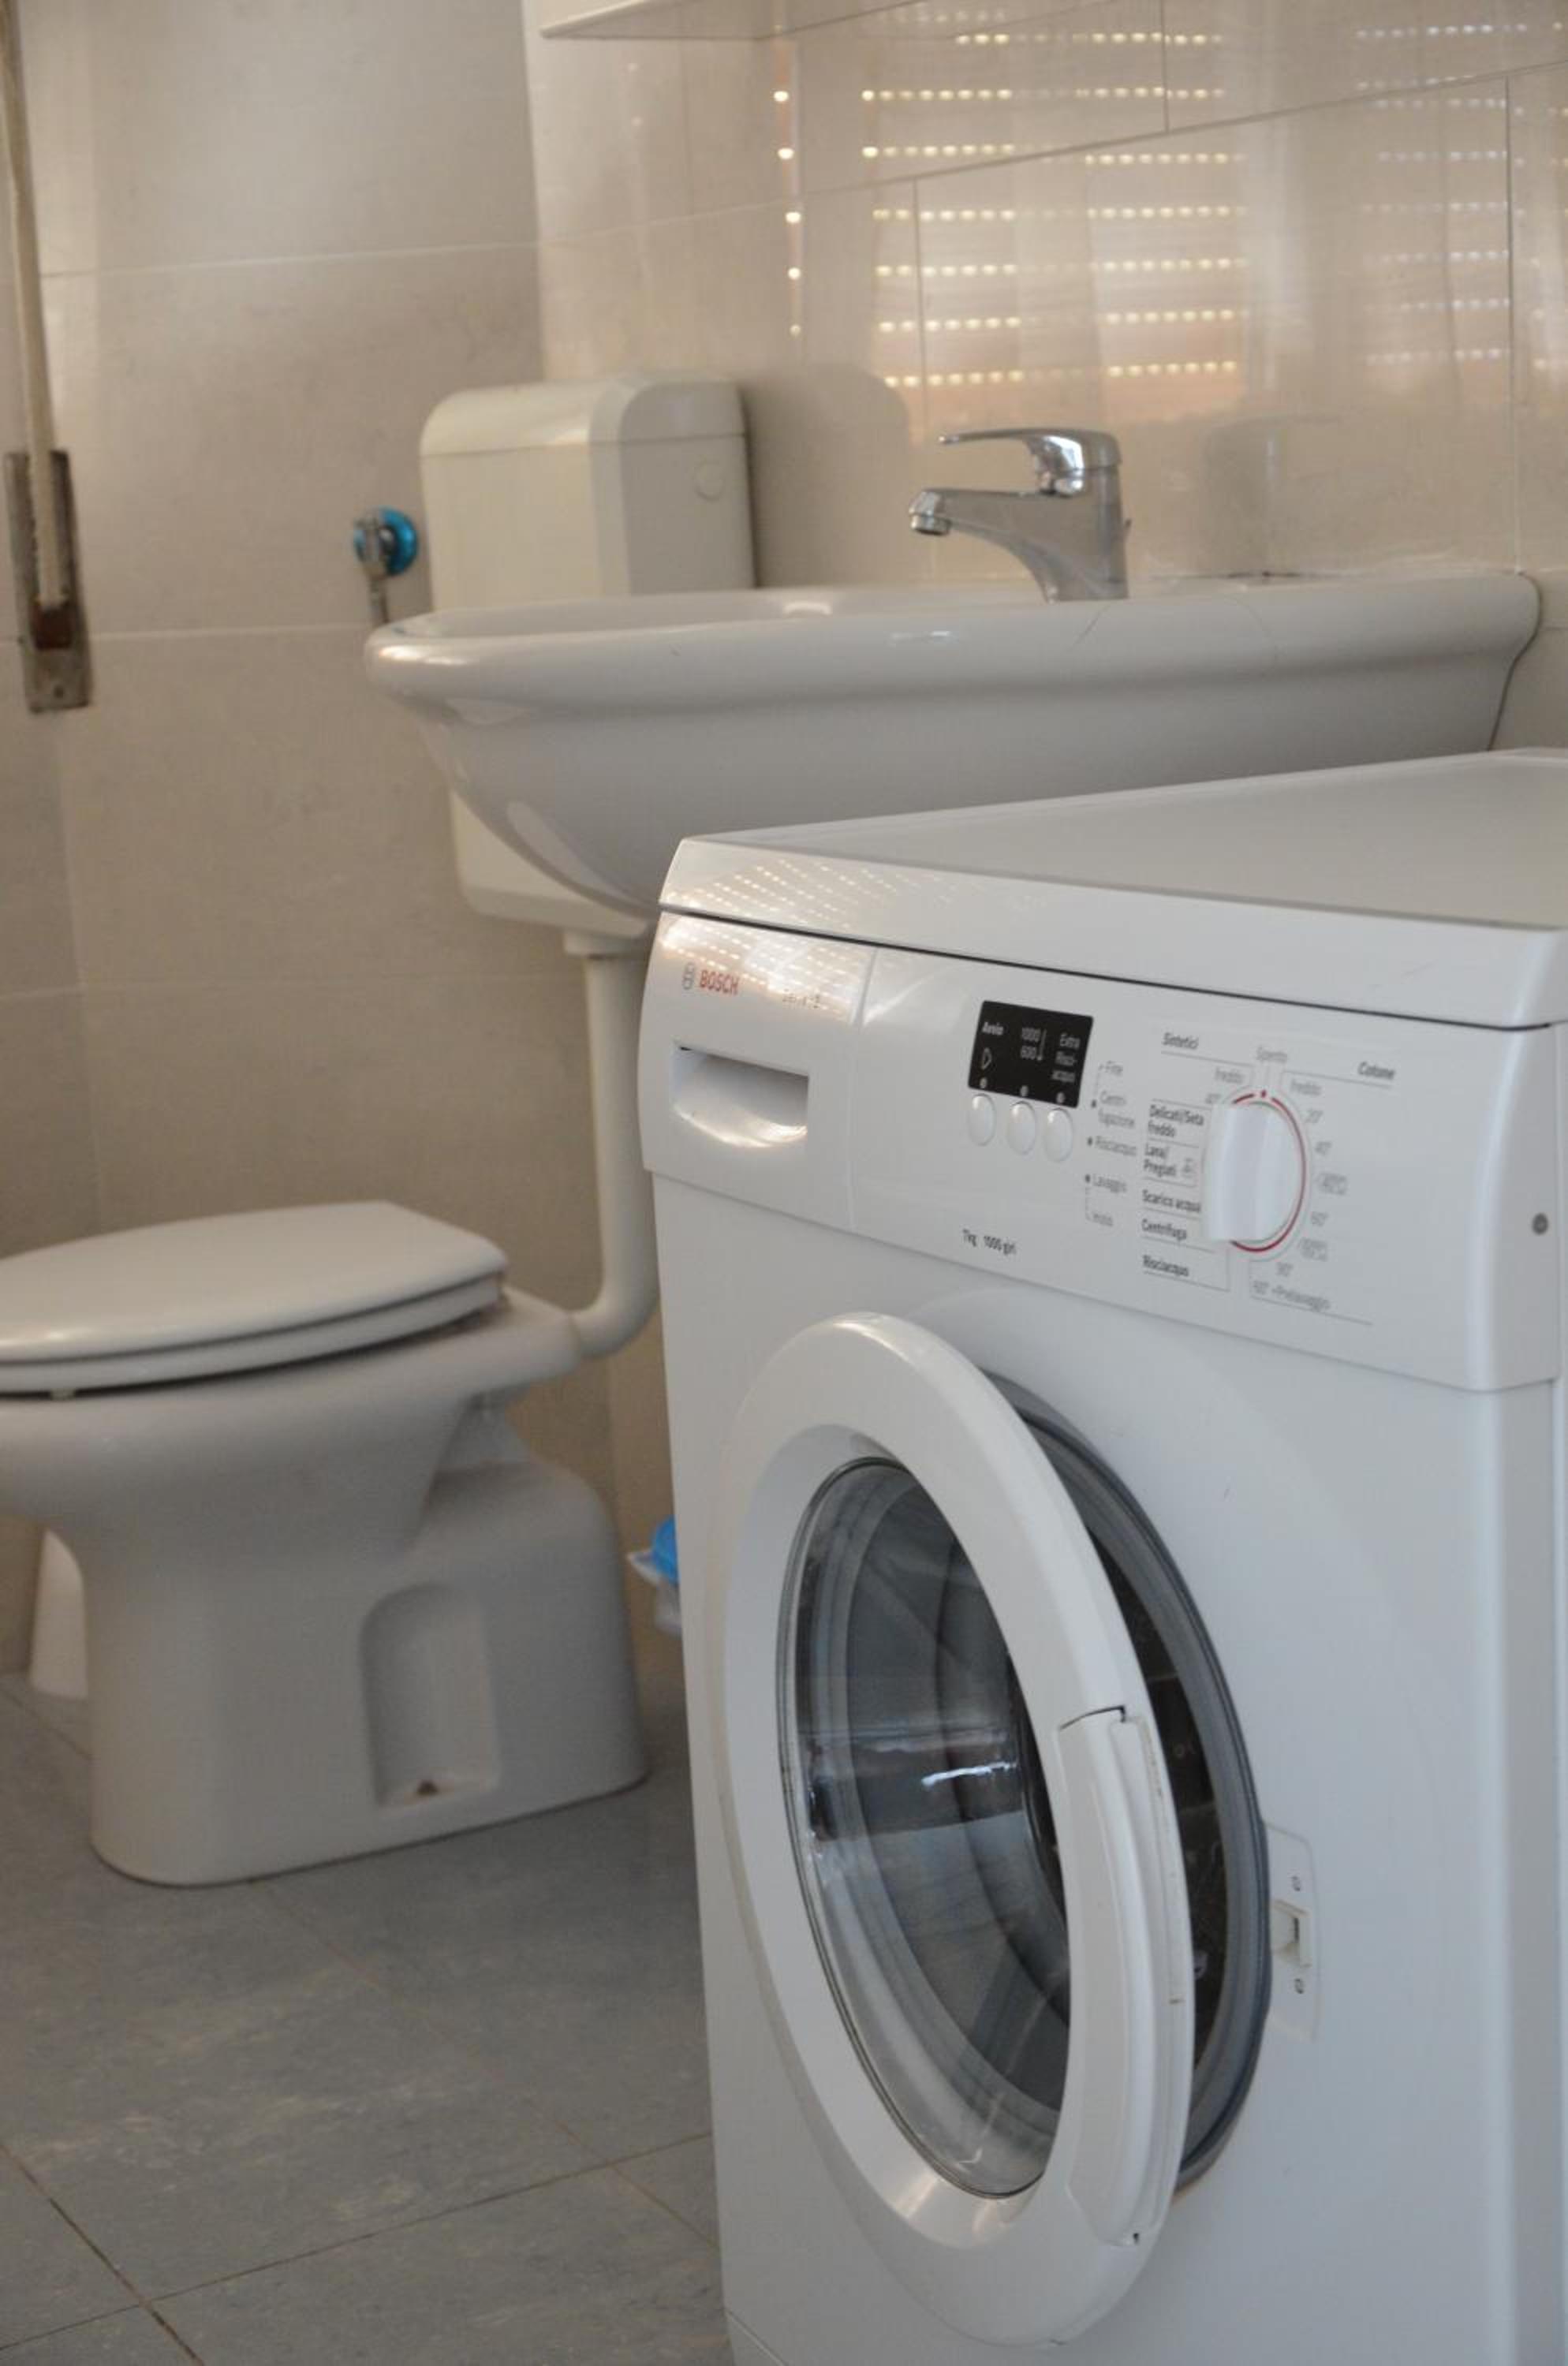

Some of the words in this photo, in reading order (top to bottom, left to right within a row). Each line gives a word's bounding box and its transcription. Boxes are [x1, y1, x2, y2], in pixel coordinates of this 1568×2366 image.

[700, 969, 740, 995] BOSCH
[1162, 1032, 1199, 1050] Sintetici
[1357, 1061, 1395, 1080] Cotone
[1142, 1189, 1173, 1207] Scarico
[1141, 1218, 1187, 1241] Centrifuga
